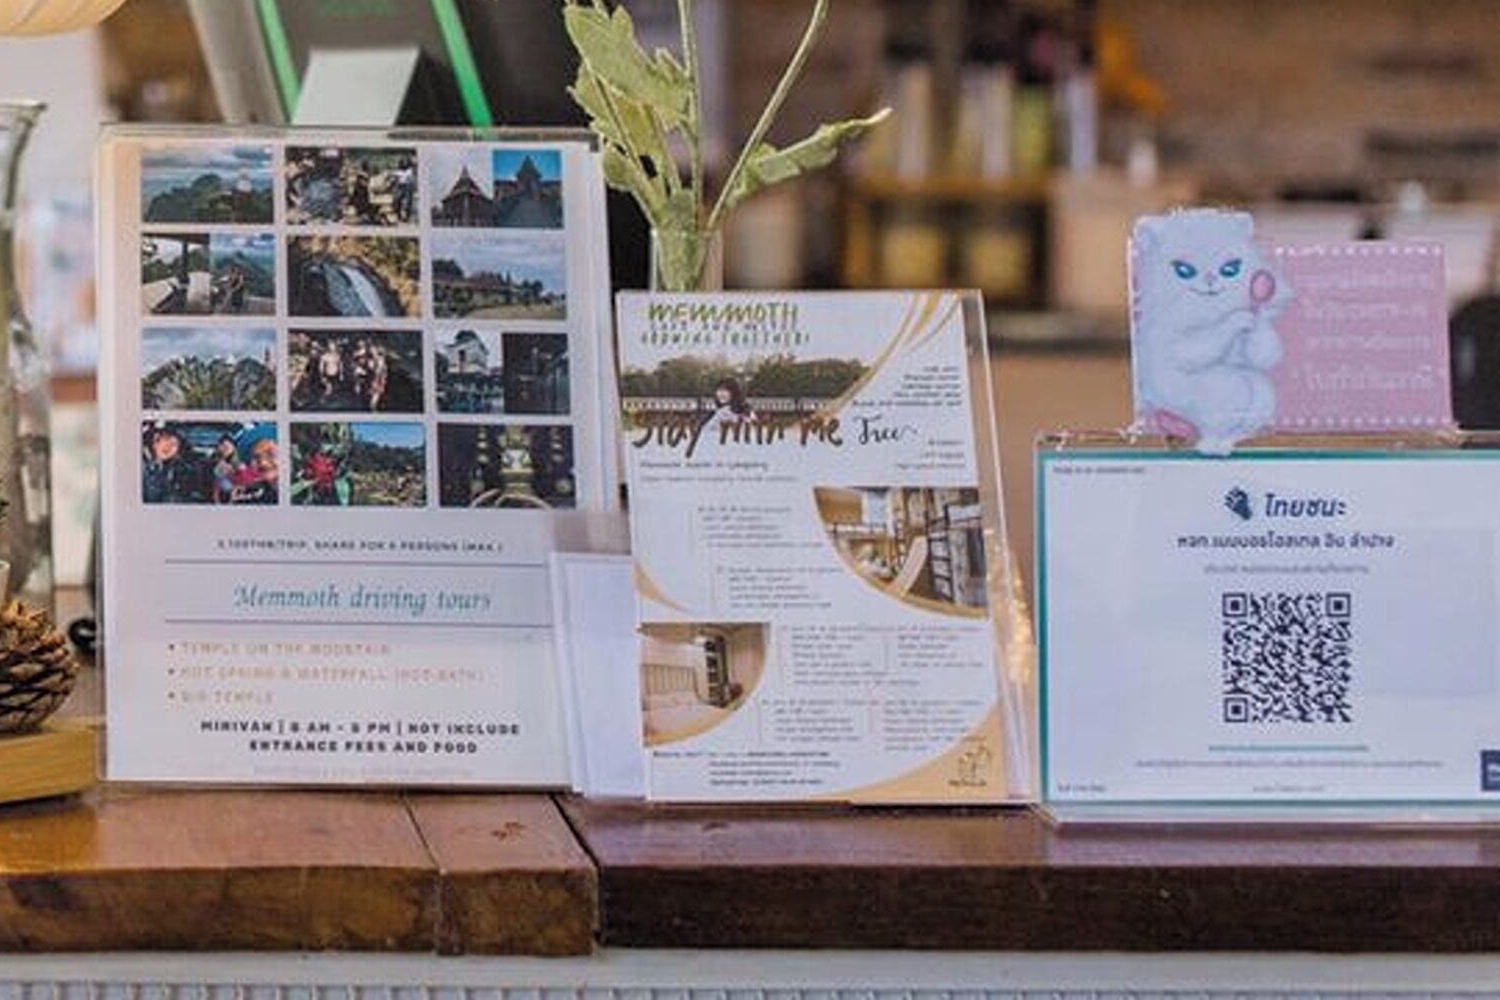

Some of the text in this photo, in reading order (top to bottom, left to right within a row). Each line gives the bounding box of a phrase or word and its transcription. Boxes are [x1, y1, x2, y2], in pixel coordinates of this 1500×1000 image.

[1265, 493, 1347, 517] ไทยชนะ
[233, 584, 492, 617] Memmoth driving tours
[200, 720, 272, 733] MINIVAN
[307, 722, 331, 734] AM
[367, 722, 391, 734] PM
[408, 722, 440, 735] NOT
[447, 722, 520, 735] INCLUDE
[249, 740, 478, 754] ENTRANCE FEES AND FOOD
